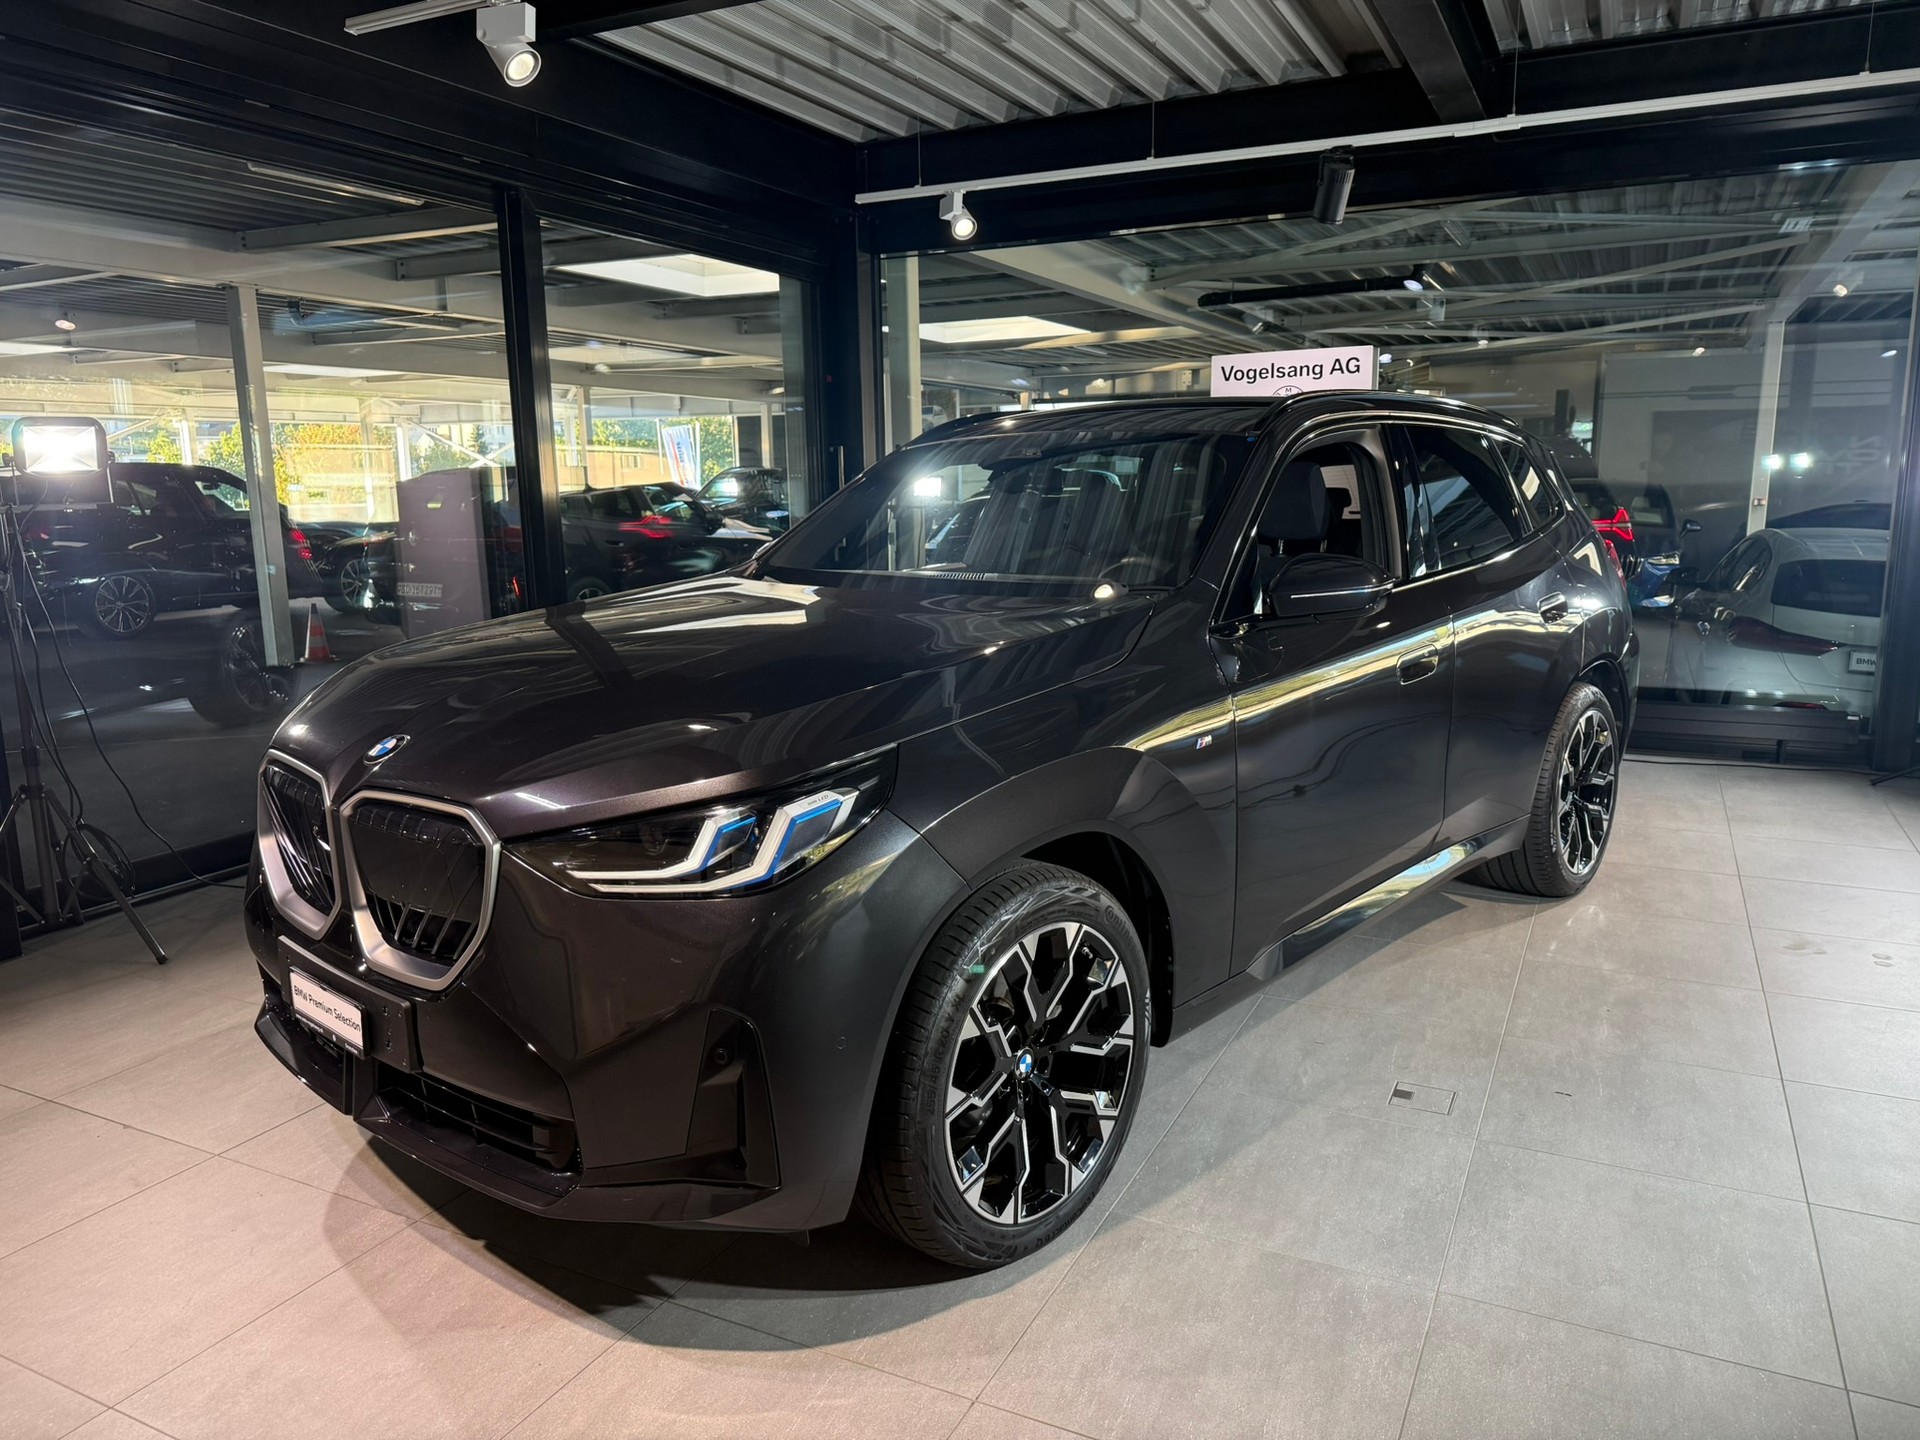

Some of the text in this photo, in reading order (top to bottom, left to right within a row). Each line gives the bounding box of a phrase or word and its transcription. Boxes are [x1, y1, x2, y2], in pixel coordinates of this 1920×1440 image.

[1221, 356, 1361, 385] Vogelsang AG
[293, 984, 308, 1002] BMW
[308, 993, 334, 1016] Premium
[333, 1008, 361, 1033] Selection
